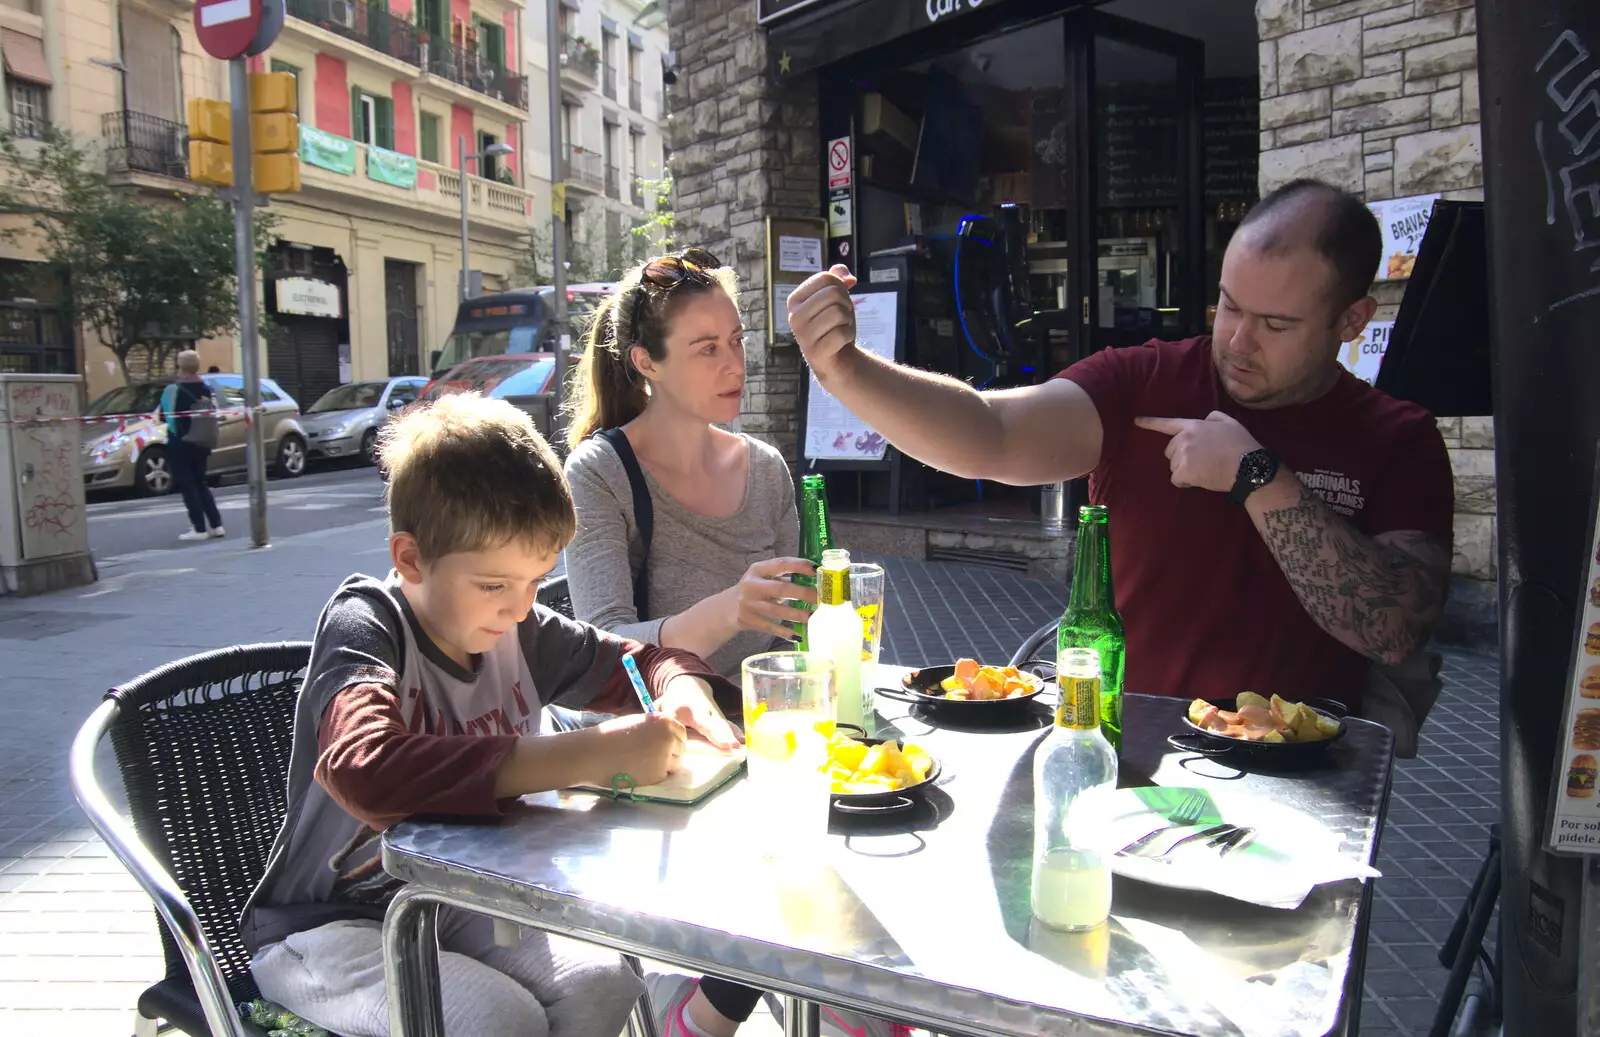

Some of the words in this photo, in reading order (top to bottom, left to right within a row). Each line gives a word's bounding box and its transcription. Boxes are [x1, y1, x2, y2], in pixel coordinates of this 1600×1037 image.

[1391, 210, 1430, 240] BRAVAS
[817, 500, 827, 538] Heineken
[1561, 820, 1582, 830] Por
